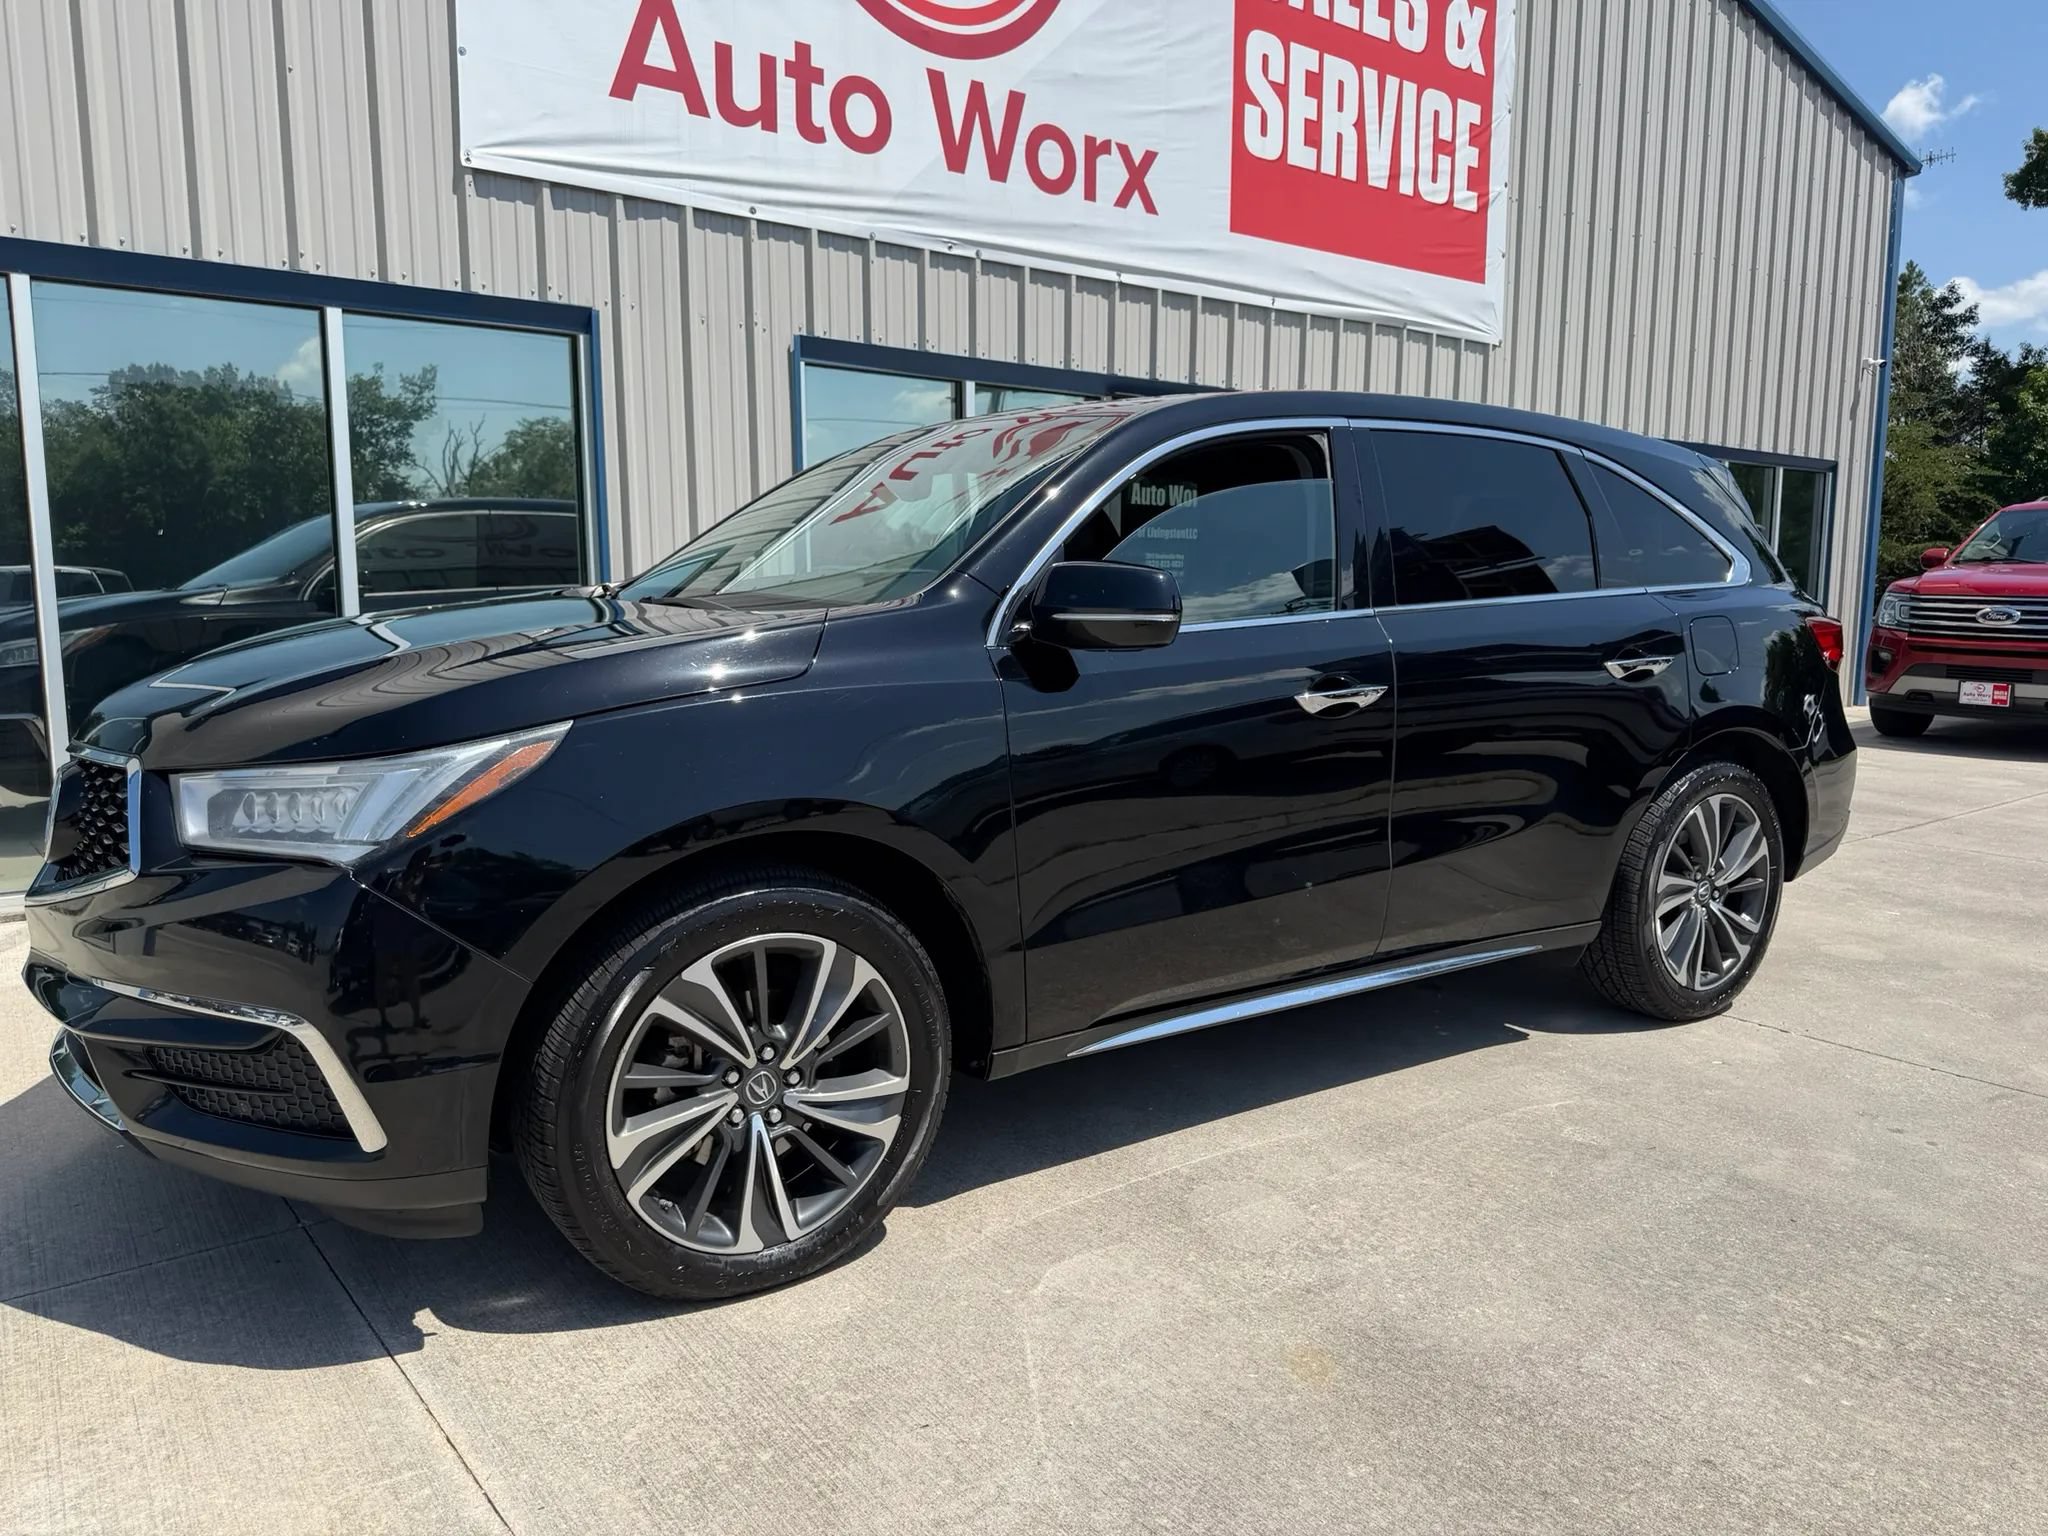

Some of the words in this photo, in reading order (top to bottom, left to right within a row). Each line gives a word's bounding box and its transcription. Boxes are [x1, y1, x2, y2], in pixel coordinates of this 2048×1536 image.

[608, 0, 892, 155] Auto
[926, 67, 1160, 216] Worx
[1243, 28, 1482, 213] SERVICE
[1131, 483, 1164, 506] Auto
[1168, 484, 1198, 508] Wor
[1986, 611, 2008, 621] Ford
